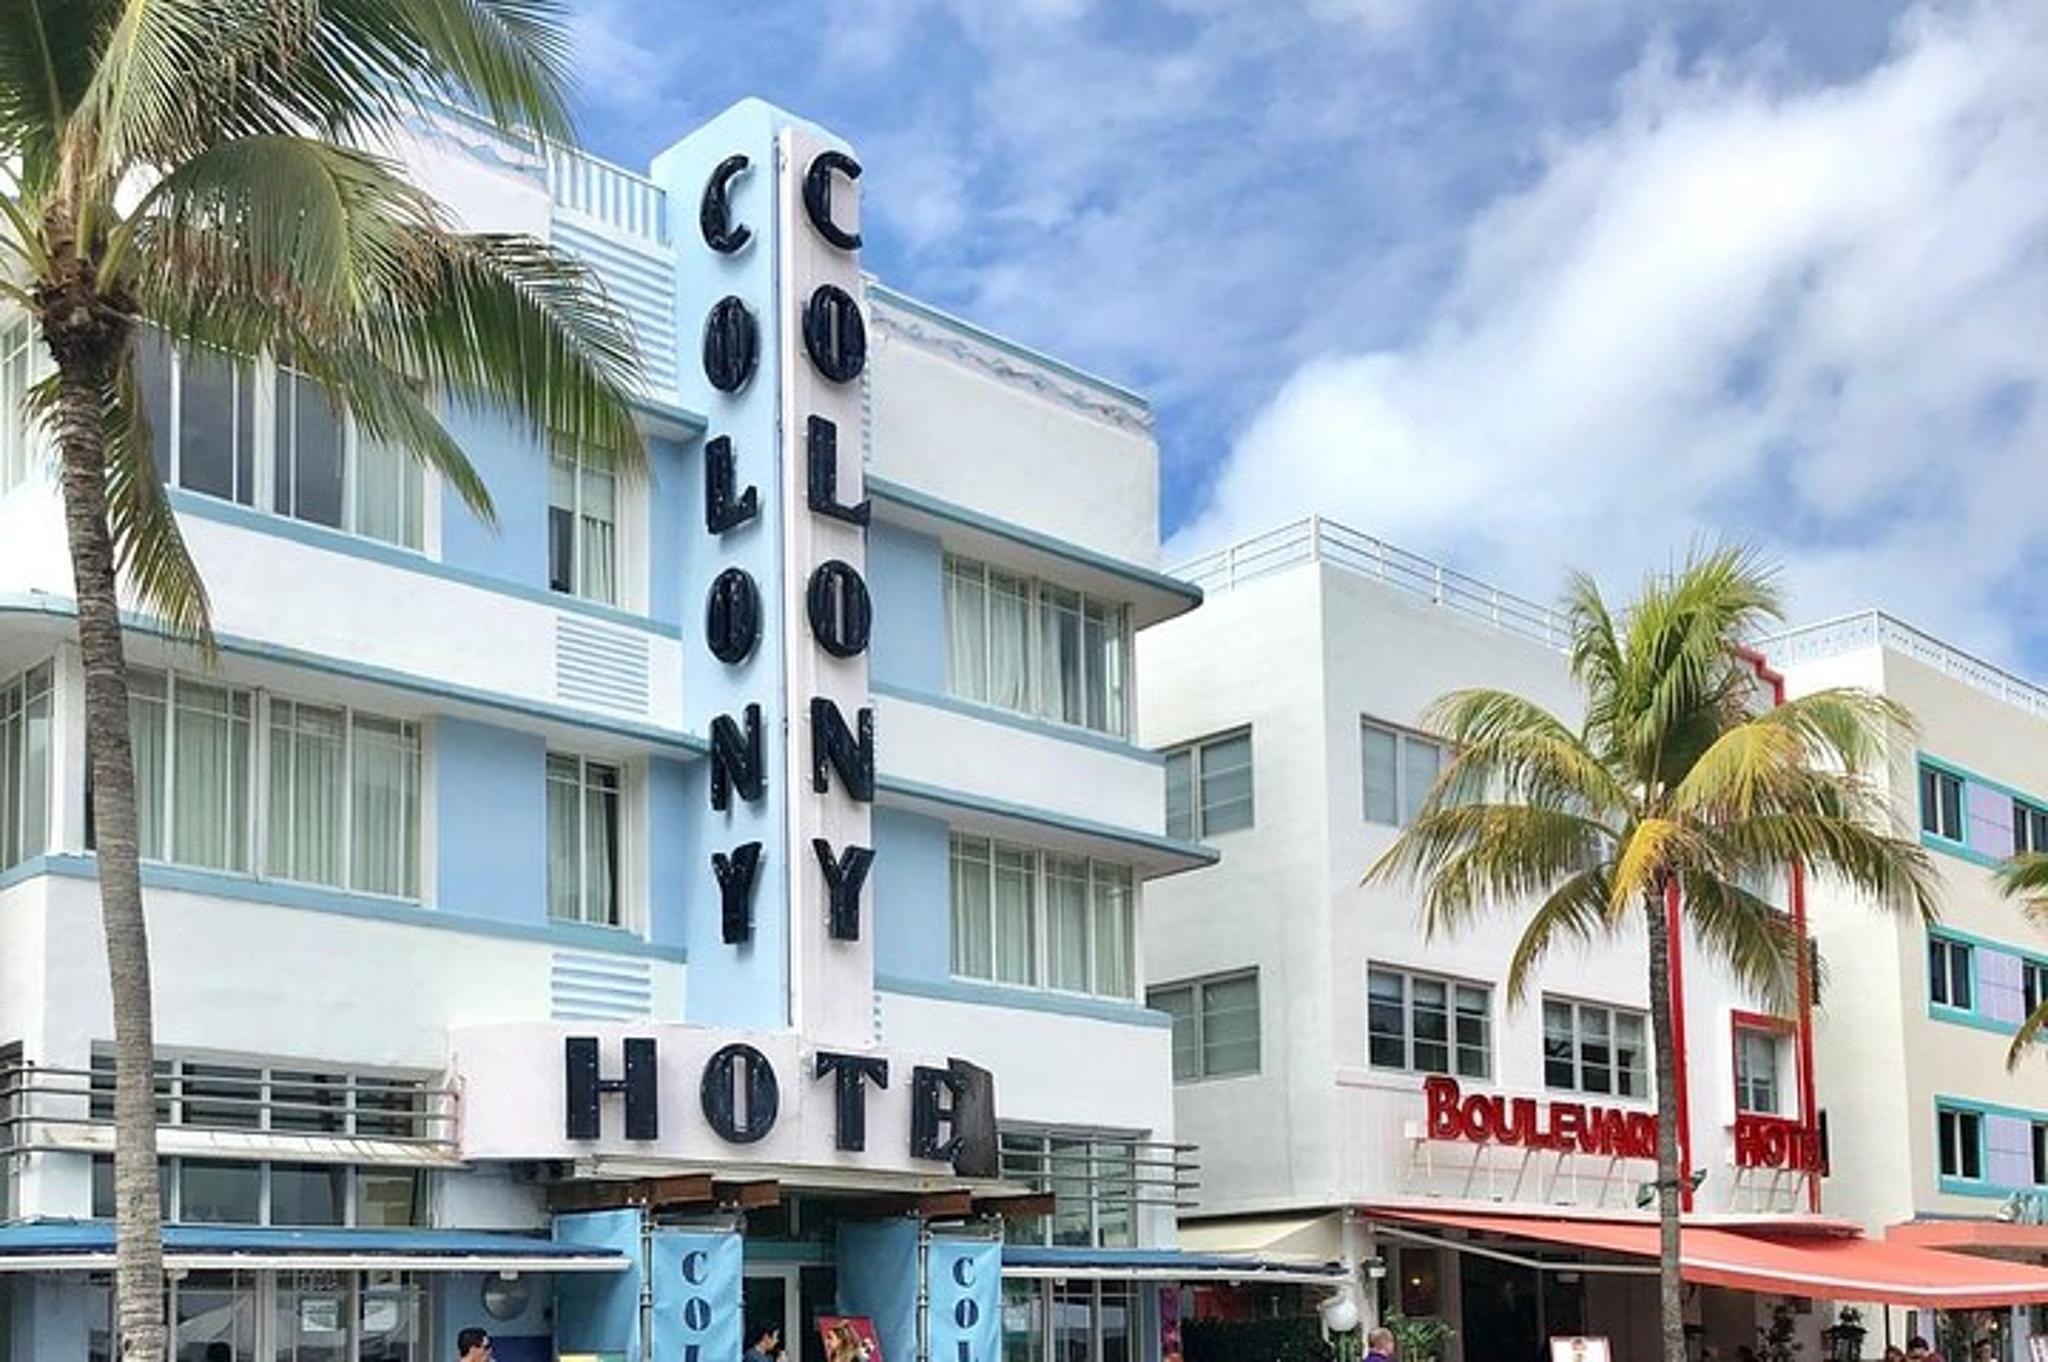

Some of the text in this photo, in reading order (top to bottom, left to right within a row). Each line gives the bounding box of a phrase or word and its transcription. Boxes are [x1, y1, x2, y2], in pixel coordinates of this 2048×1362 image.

[700, 154, 763, 944] COLONY
[802, 150, 876, 941] COLONY
[565, 1036, 1000, 1178] HOTE
[1424, 1075, 1659, 1158] BOULEVAR
